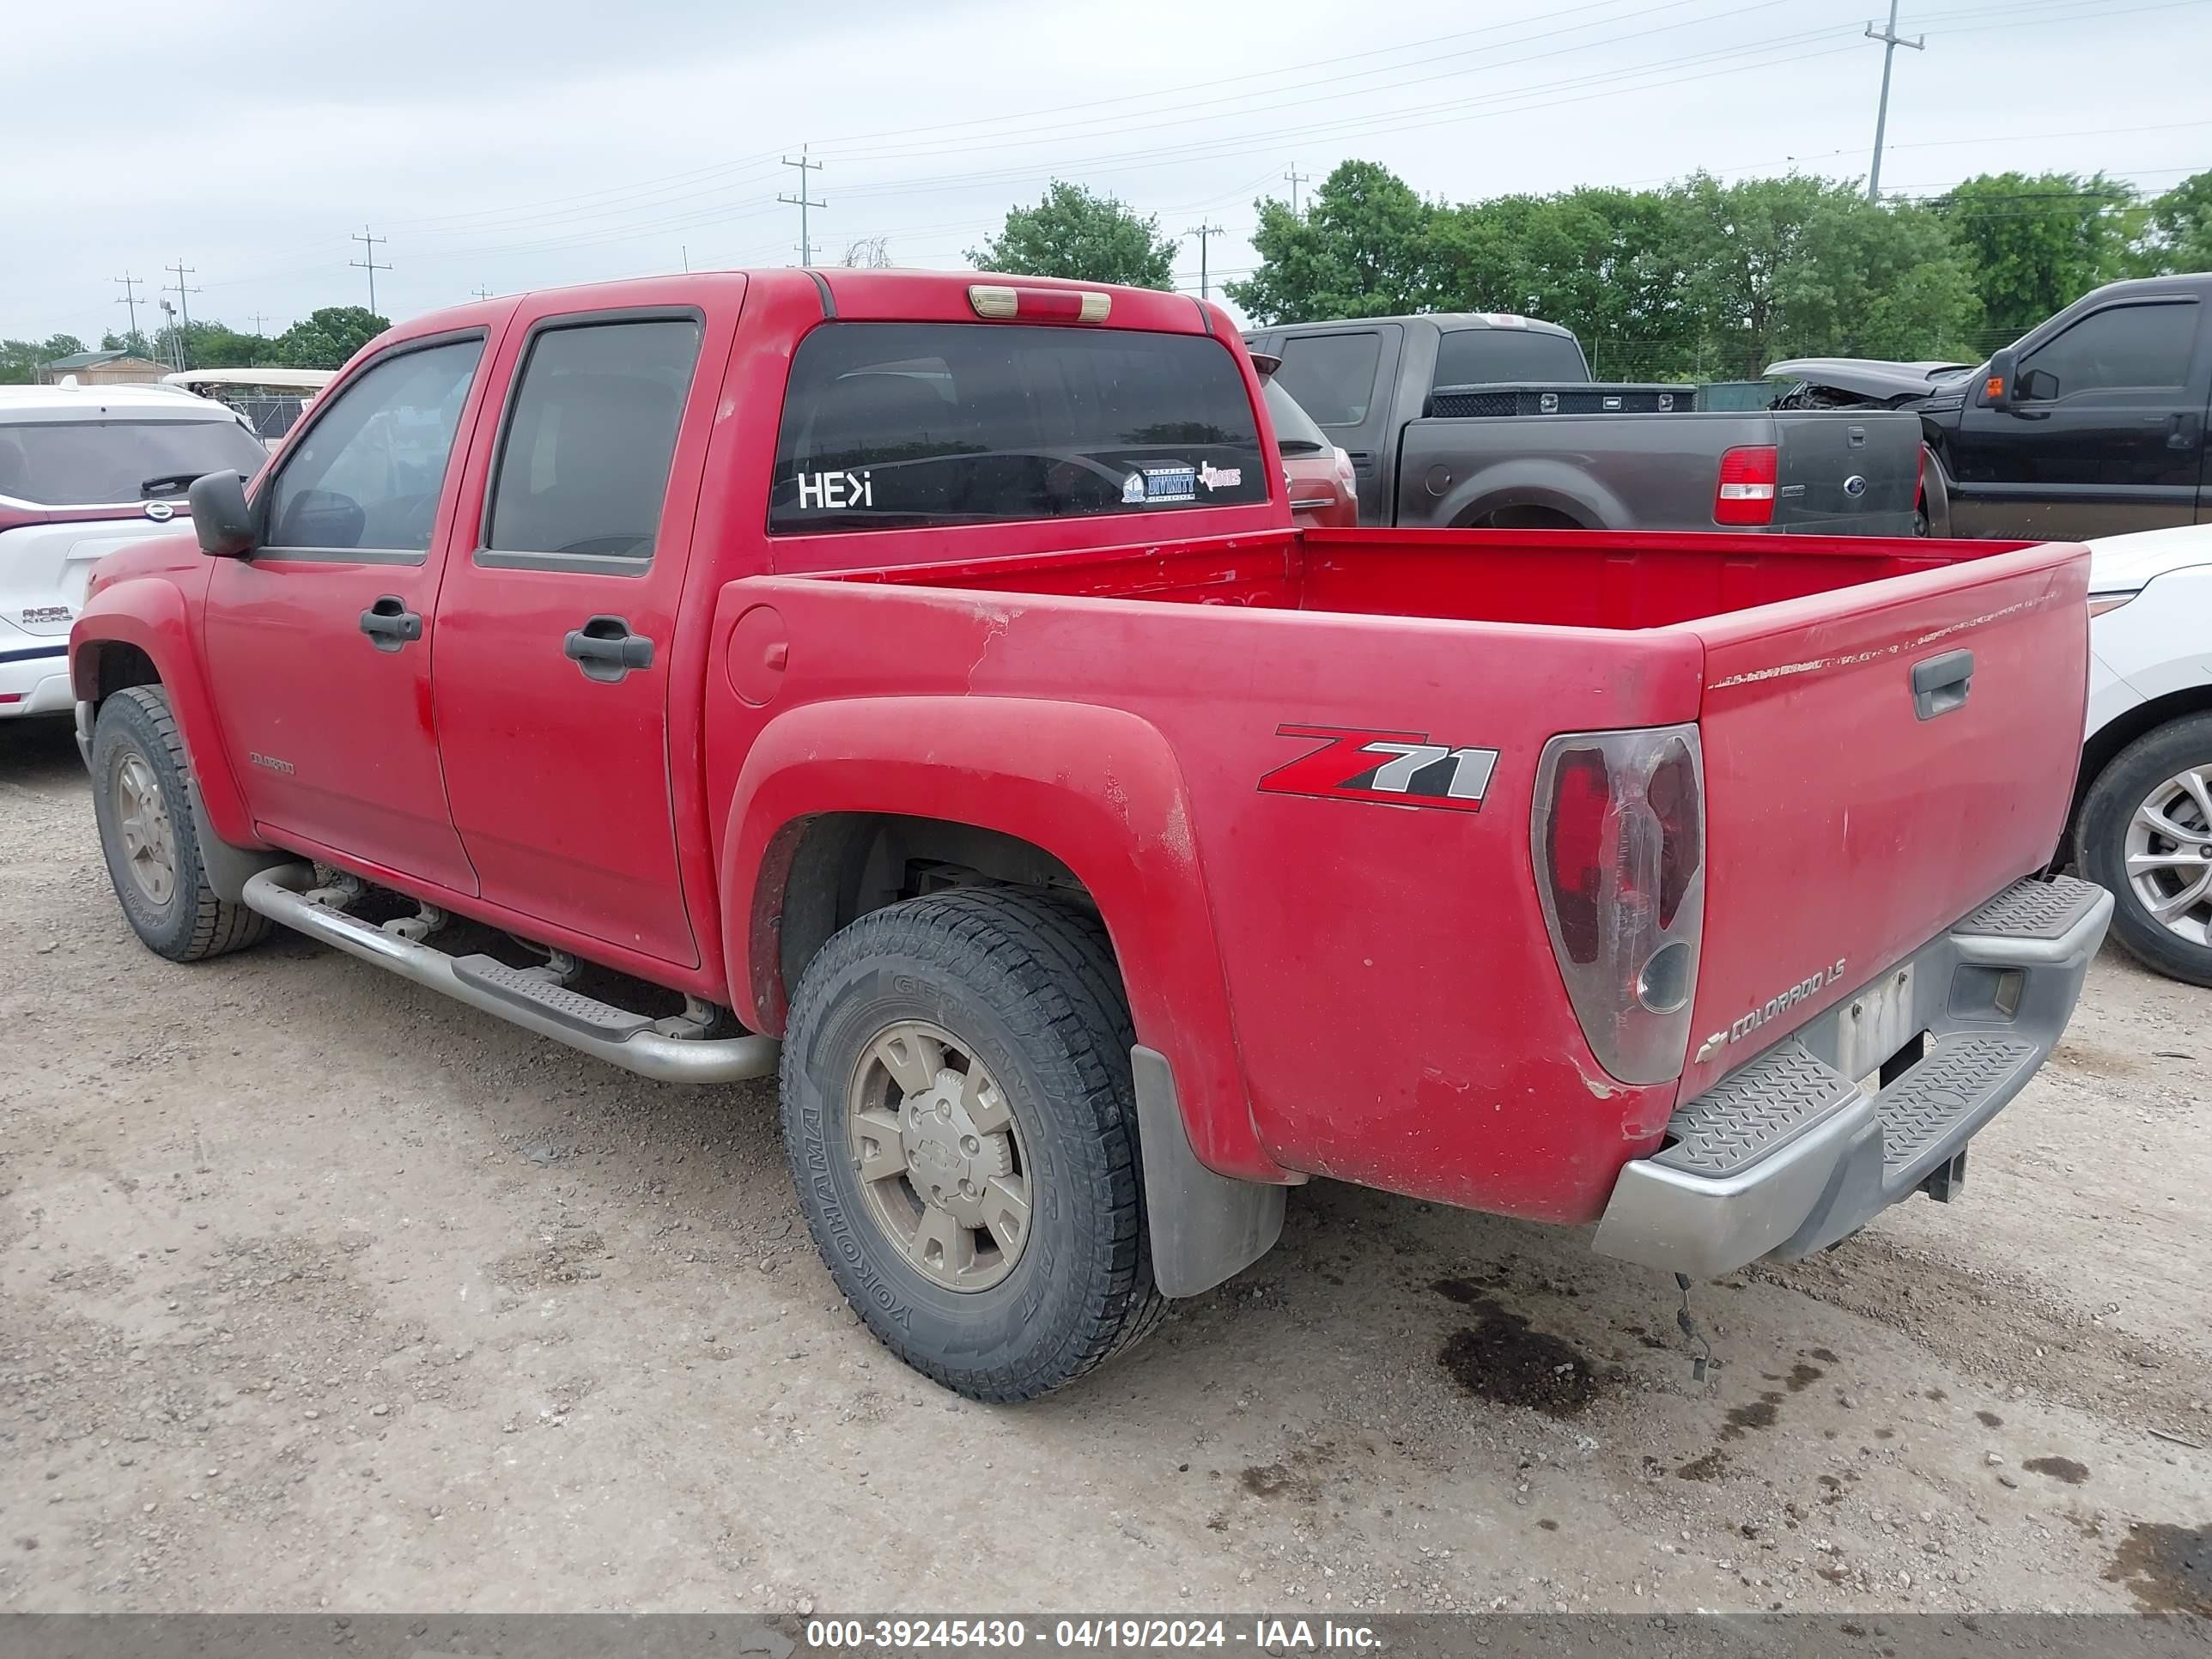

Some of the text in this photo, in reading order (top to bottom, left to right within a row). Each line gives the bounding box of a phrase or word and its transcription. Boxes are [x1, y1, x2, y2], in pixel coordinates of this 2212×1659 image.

[1148, 474, 1195, 495] DIVINITY
[22, 606, 70, 617] ANCIRA
[1257, 723, 1502, 813] Z71
[1729, 957, 1846, 1044] COLORADO LS
[804, 1107, 914, 1331] YOKOHAMA
